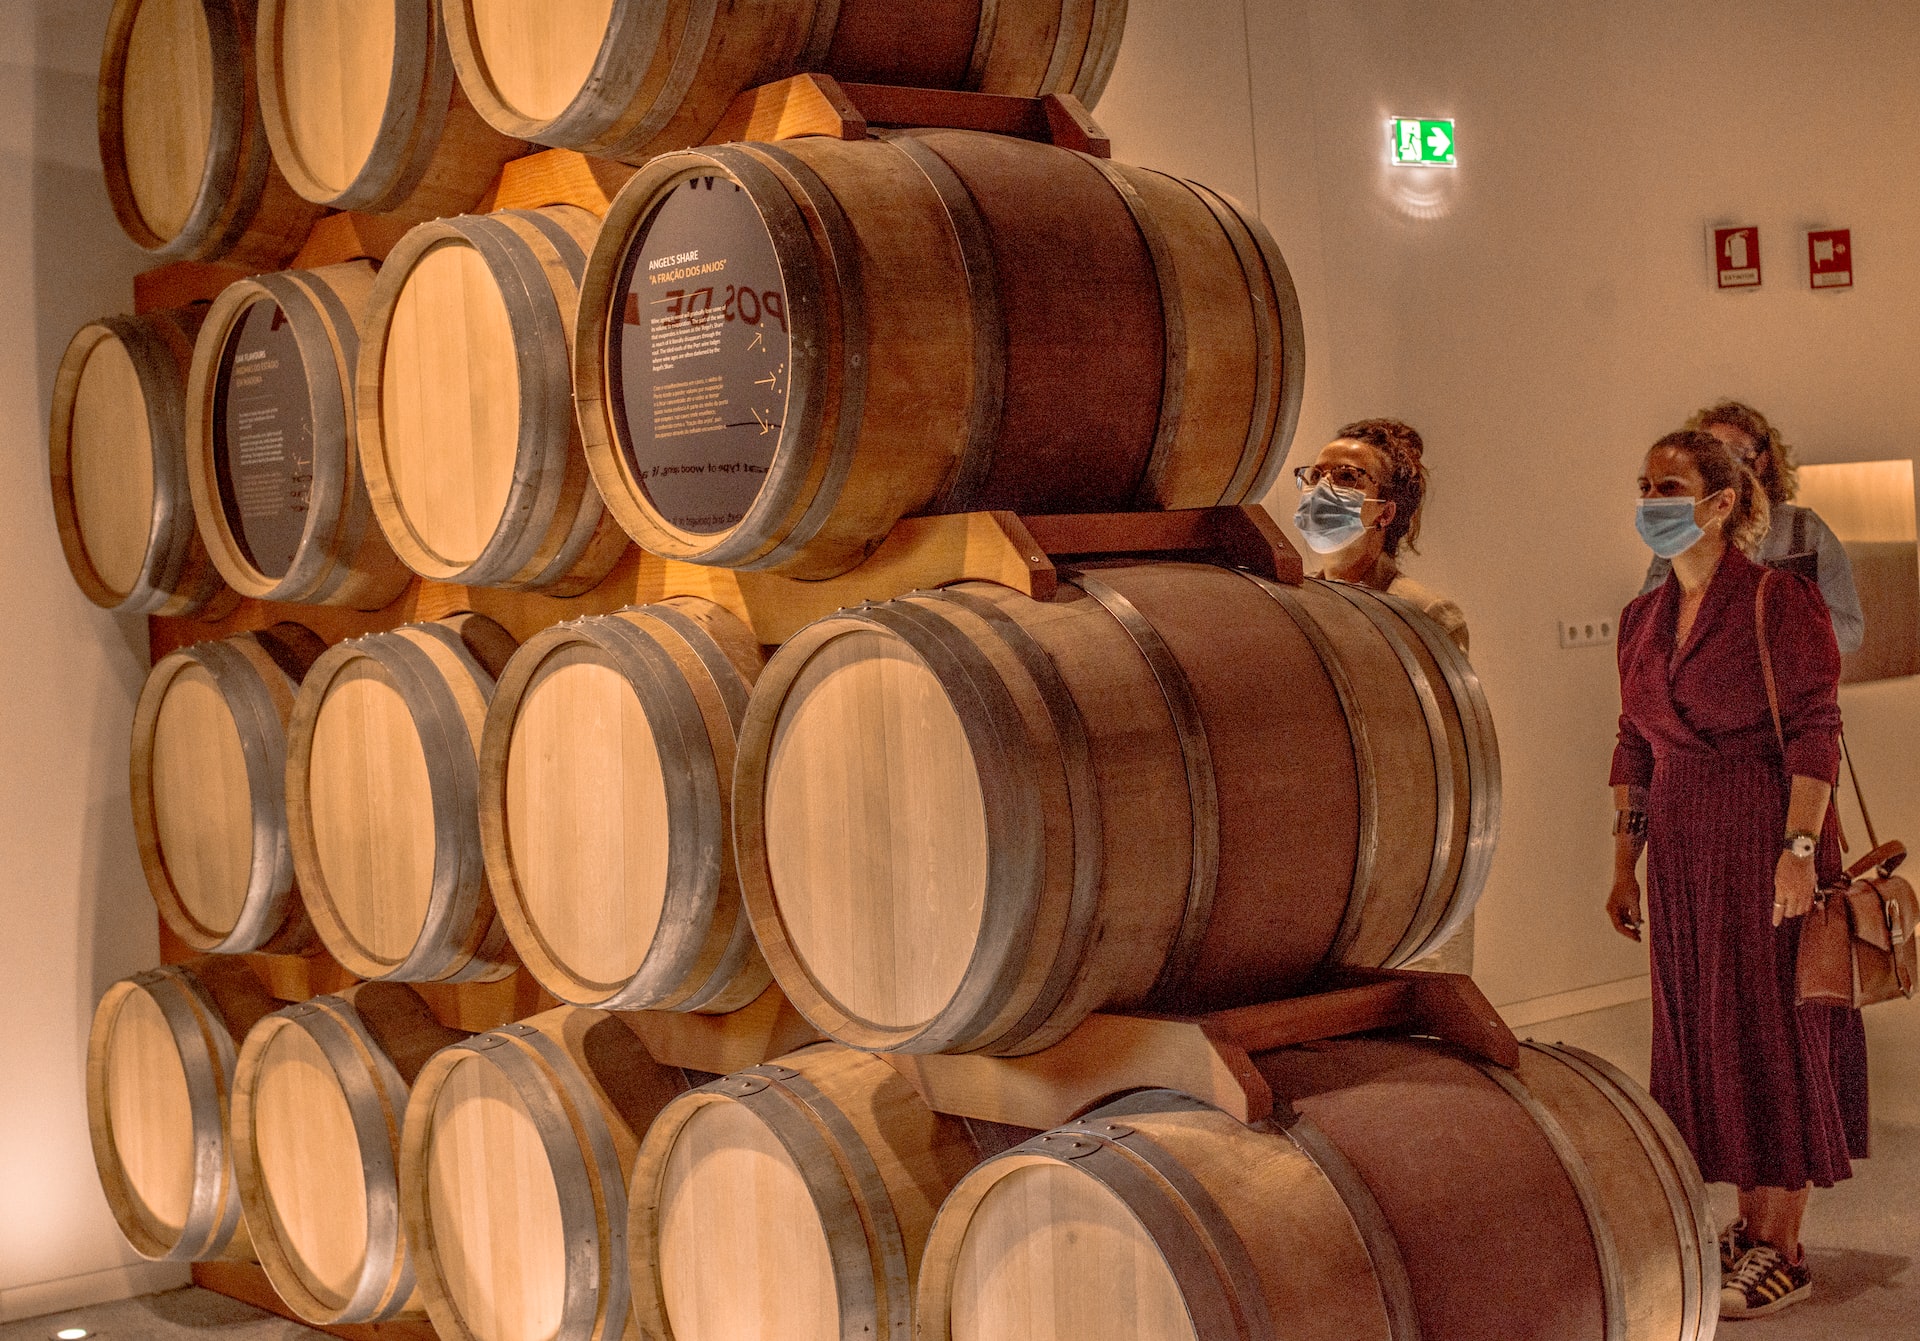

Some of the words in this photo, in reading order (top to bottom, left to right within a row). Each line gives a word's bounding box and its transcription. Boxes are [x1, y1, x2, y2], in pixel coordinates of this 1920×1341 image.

[648, 255, 676, 270] ANGEL'S
[676, 250, 699, 264] SHARE
[658, 268, 684, 284] FRAÇÃO
[685, 266, 700, 278] DOS
